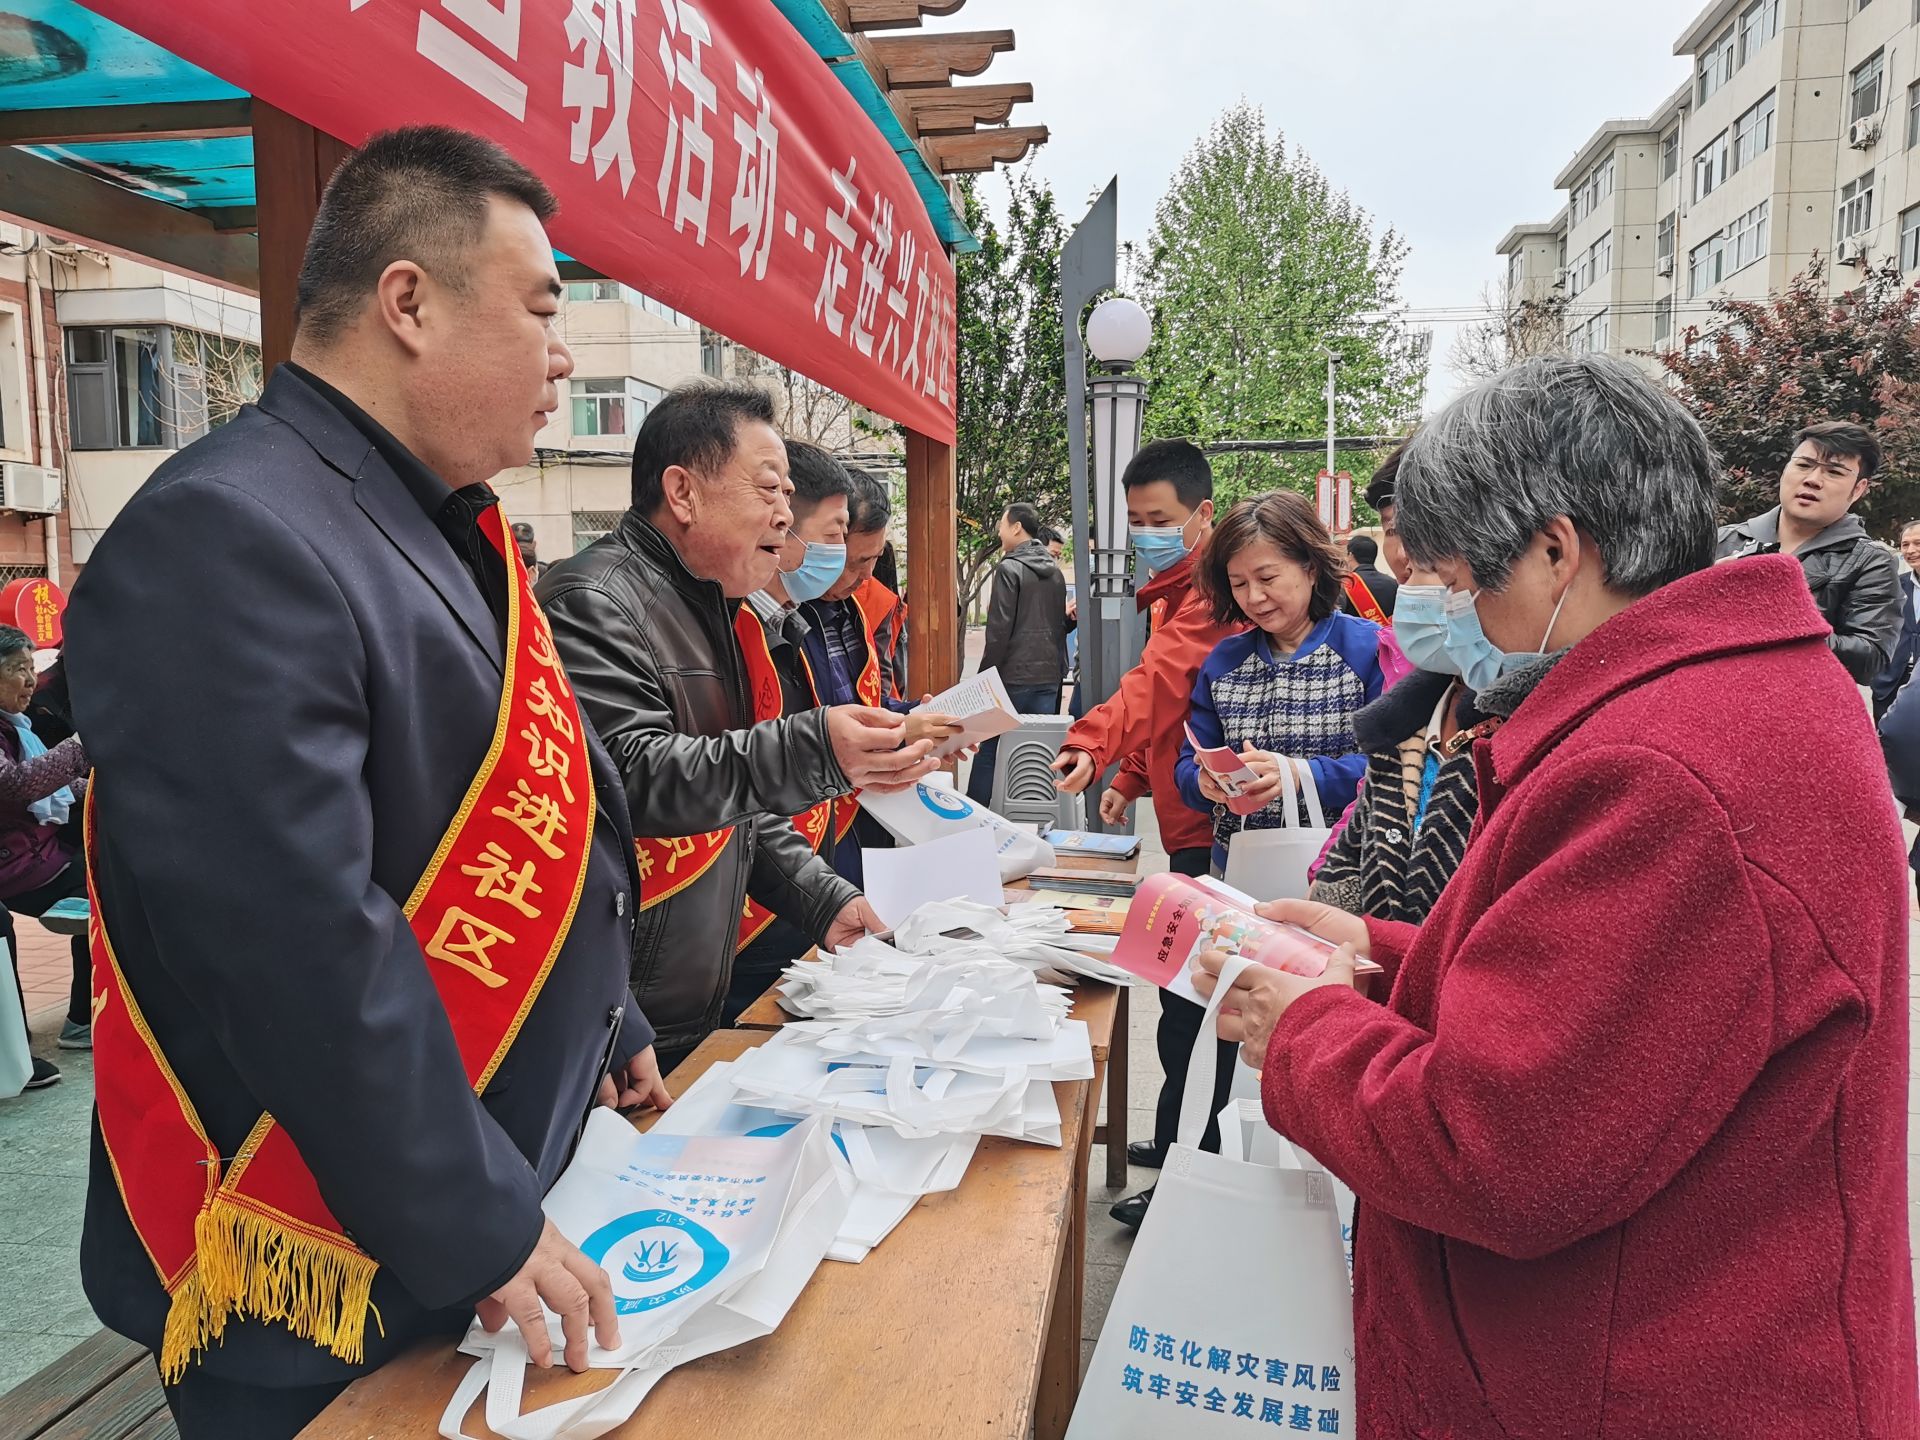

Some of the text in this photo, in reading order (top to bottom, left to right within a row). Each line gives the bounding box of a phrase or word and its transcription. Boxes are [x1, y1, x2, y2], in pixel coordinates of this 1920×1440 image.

[613, 1285, 695, 1312] 防灾减
[1128, 1325, 1342, 1392] 防范化解灾害风险
[1121, 1364, 1341, 1435] 筑牢安全发展基础
